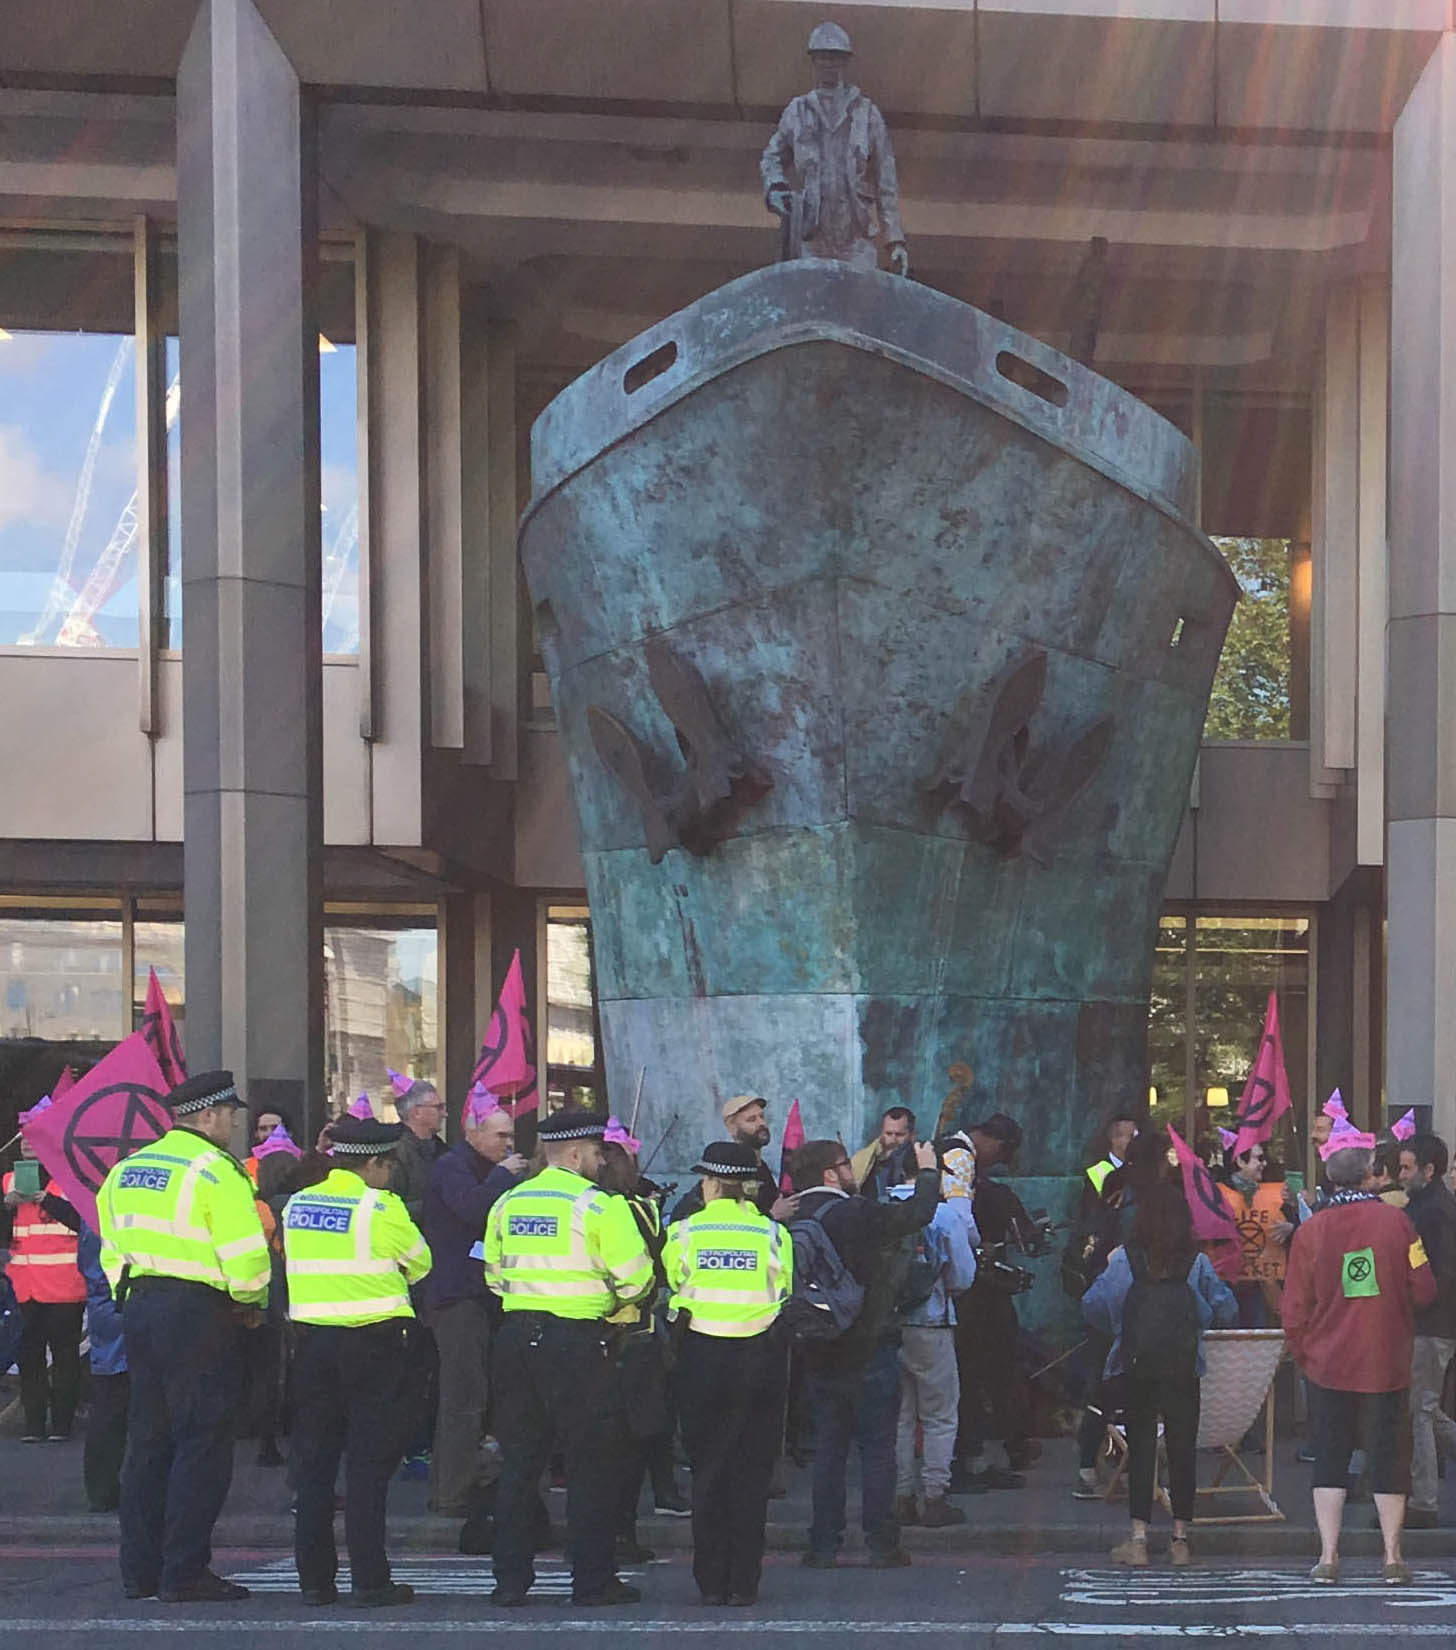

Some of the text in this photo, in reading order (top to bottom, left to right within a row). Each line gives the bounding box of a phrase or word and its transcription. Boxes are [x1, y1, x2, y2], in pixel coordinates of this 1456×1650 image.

[119, 1174, 168, 1190] POLICE
[289, 1213, 348, 1230] POLICE
[509, 1222, 556, 1236] POLICE
[698, 1256, 756, 1270] POLICE
